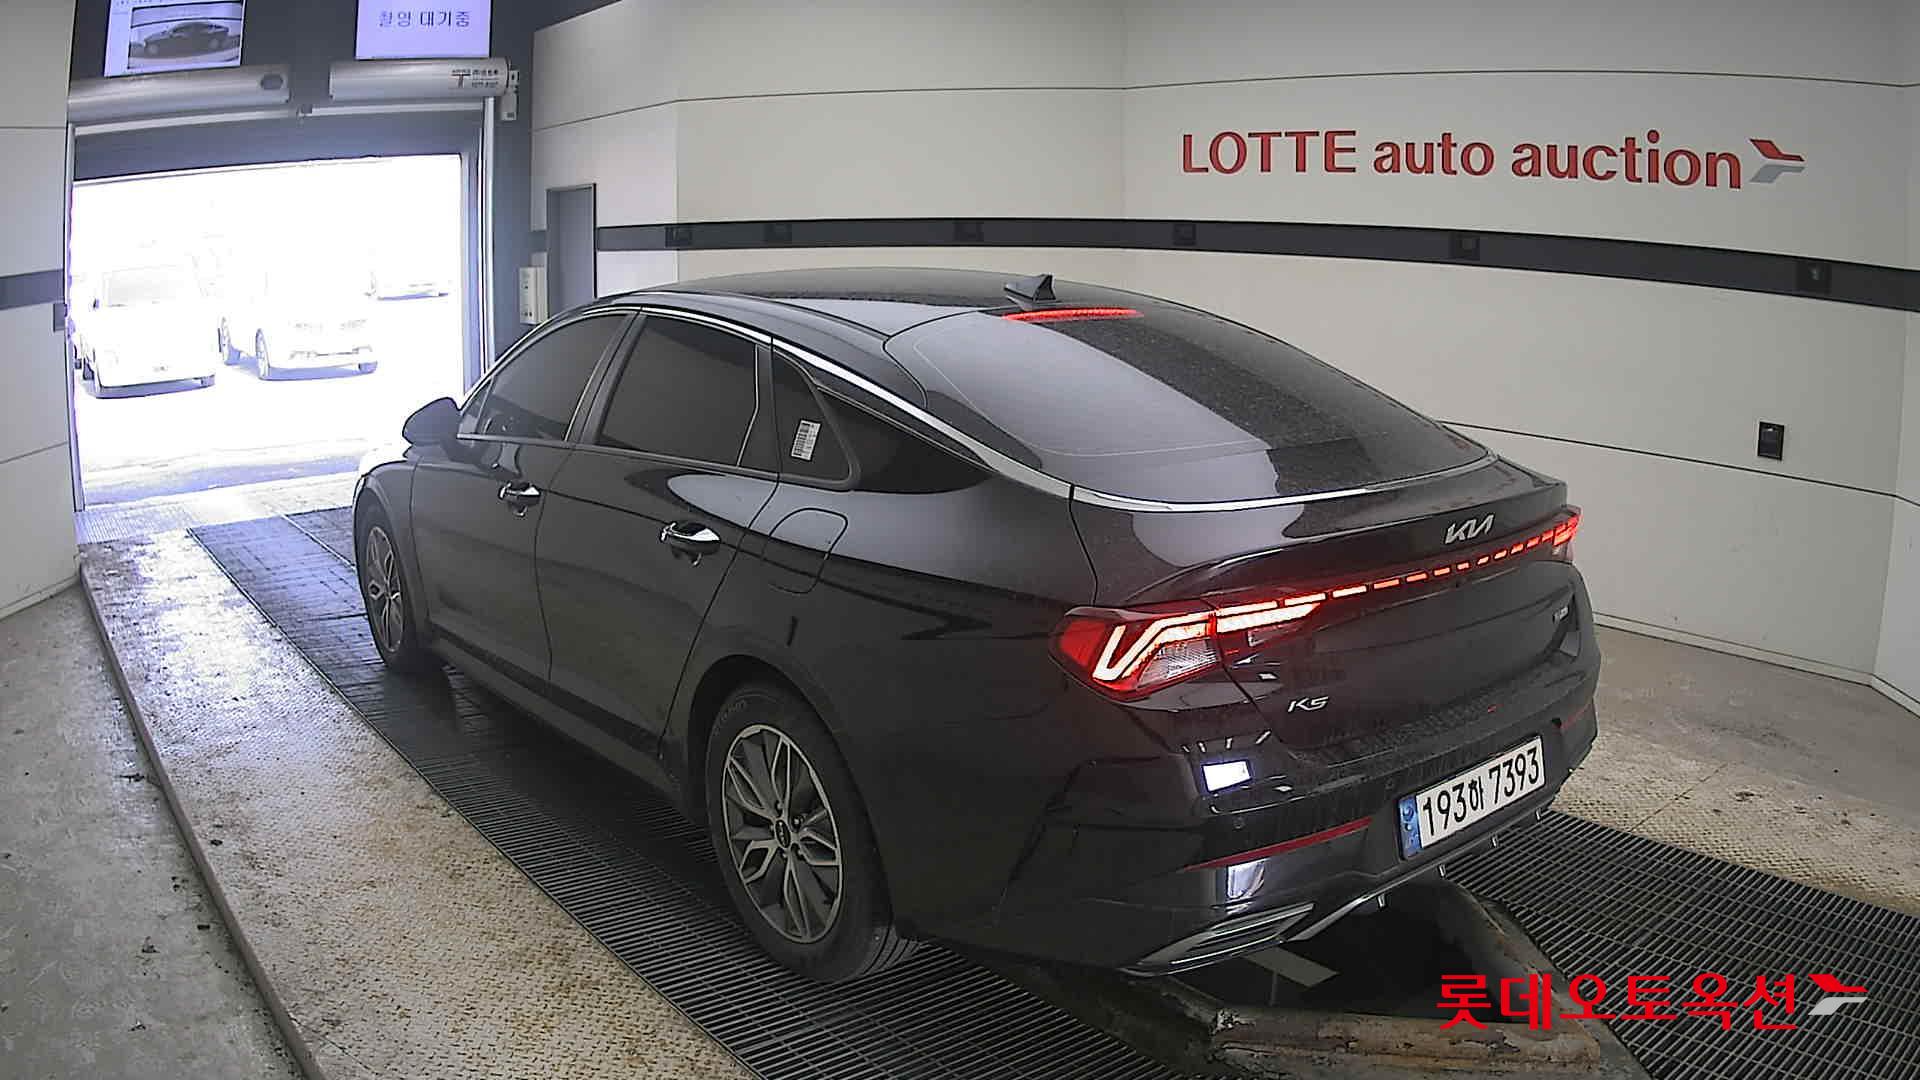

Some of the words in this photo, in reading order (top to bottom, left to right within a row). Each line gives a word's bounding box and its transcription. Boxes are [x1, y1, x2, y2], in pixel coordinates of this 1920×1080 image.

[420, 10, 470, 28] 대기중
[1183, 130, 1356, 174] LOTTE
[1373, 132, 1495, 176] auto
[1511, 129, 1742, 189] auction
[1445, 514, 1494, 544] KIA
[1287, 696, 1329, 713] K5
[1422, 776, 1484, 837] 193하
[1488, 747, 1540, 805] 7393
